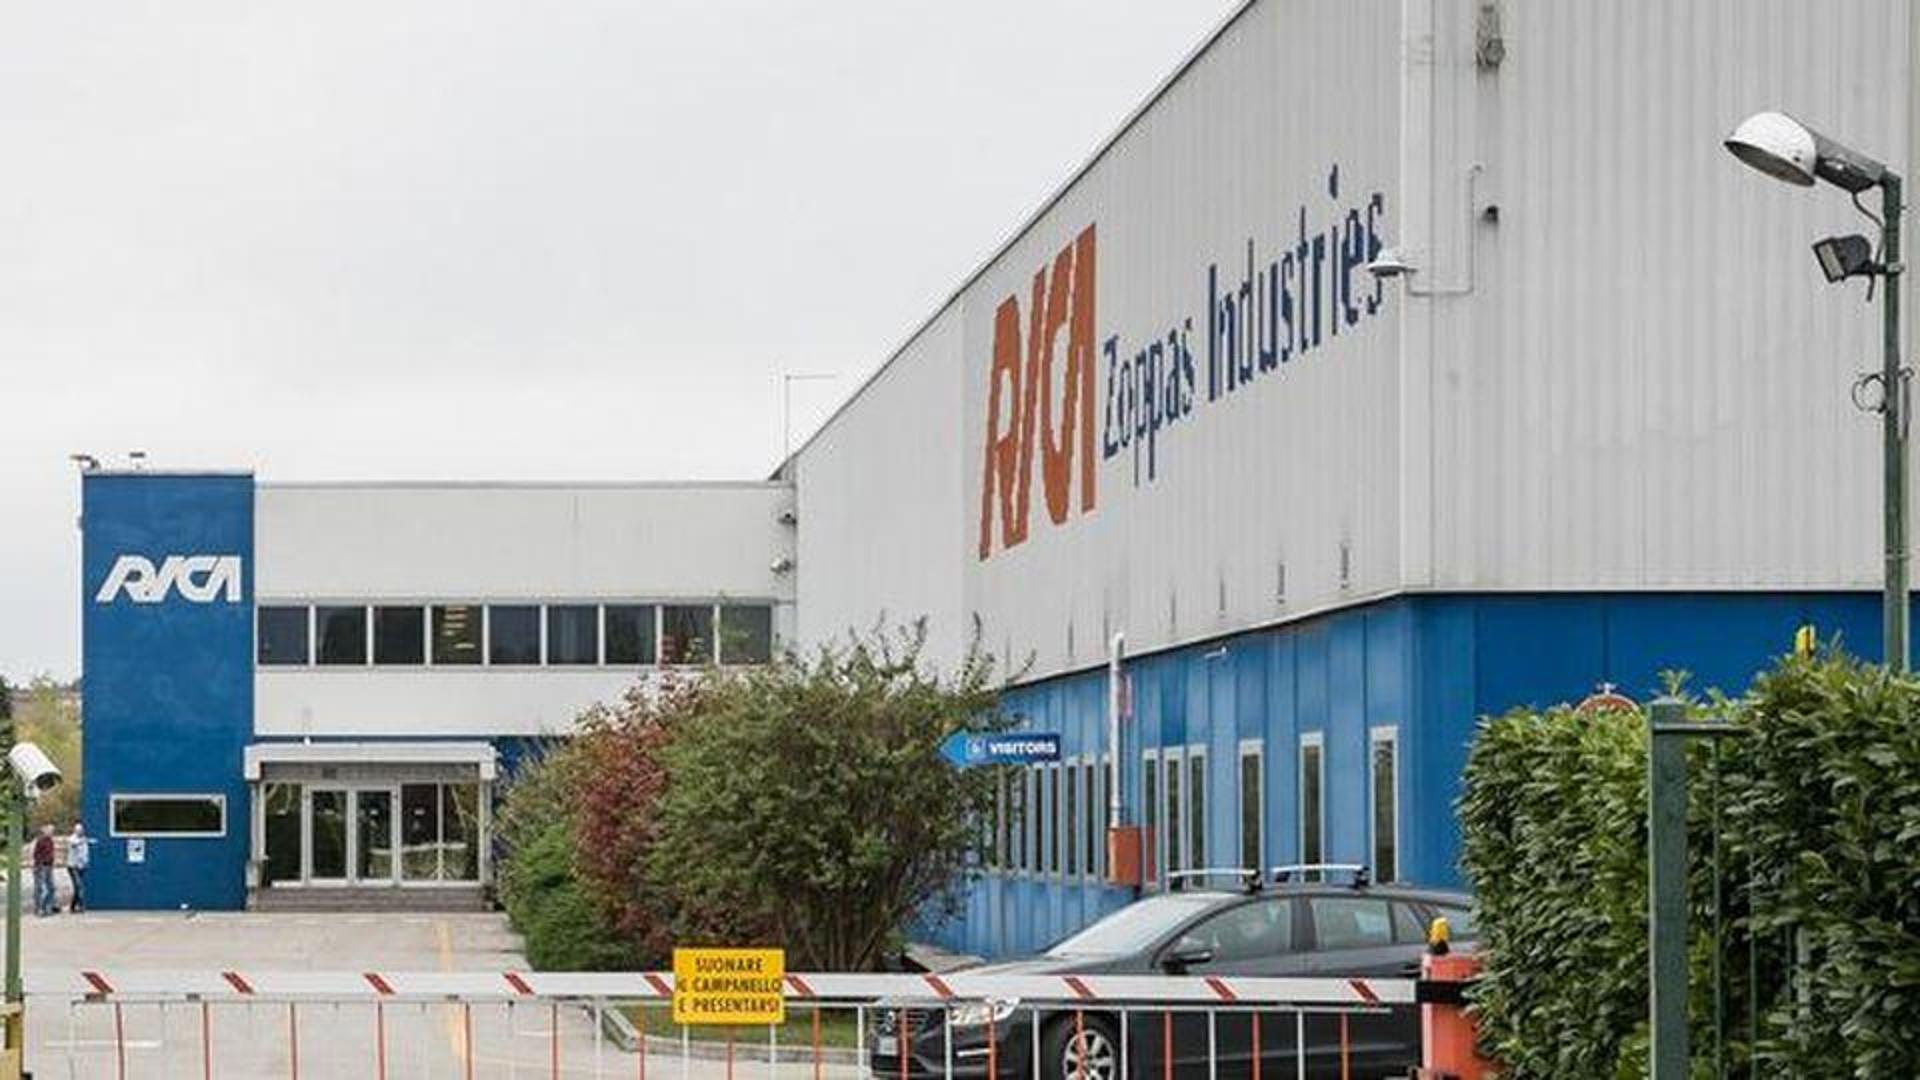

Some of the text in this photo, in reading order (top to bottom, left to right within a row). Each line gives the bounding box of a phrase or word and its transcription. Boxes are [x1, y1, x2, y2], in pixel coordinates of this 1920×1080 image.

[979, 164, 1384, 561] RICA Zoppas Industries
[96, 555, 242, 602] RICA
[989, 741, 1057, 755] VISITORS
[695, 957, 763, 972] SUONARE
[692, 978, 782, 993] CAMPANELLO
[679, 998, 779, 1013] E PRESENTARSI
